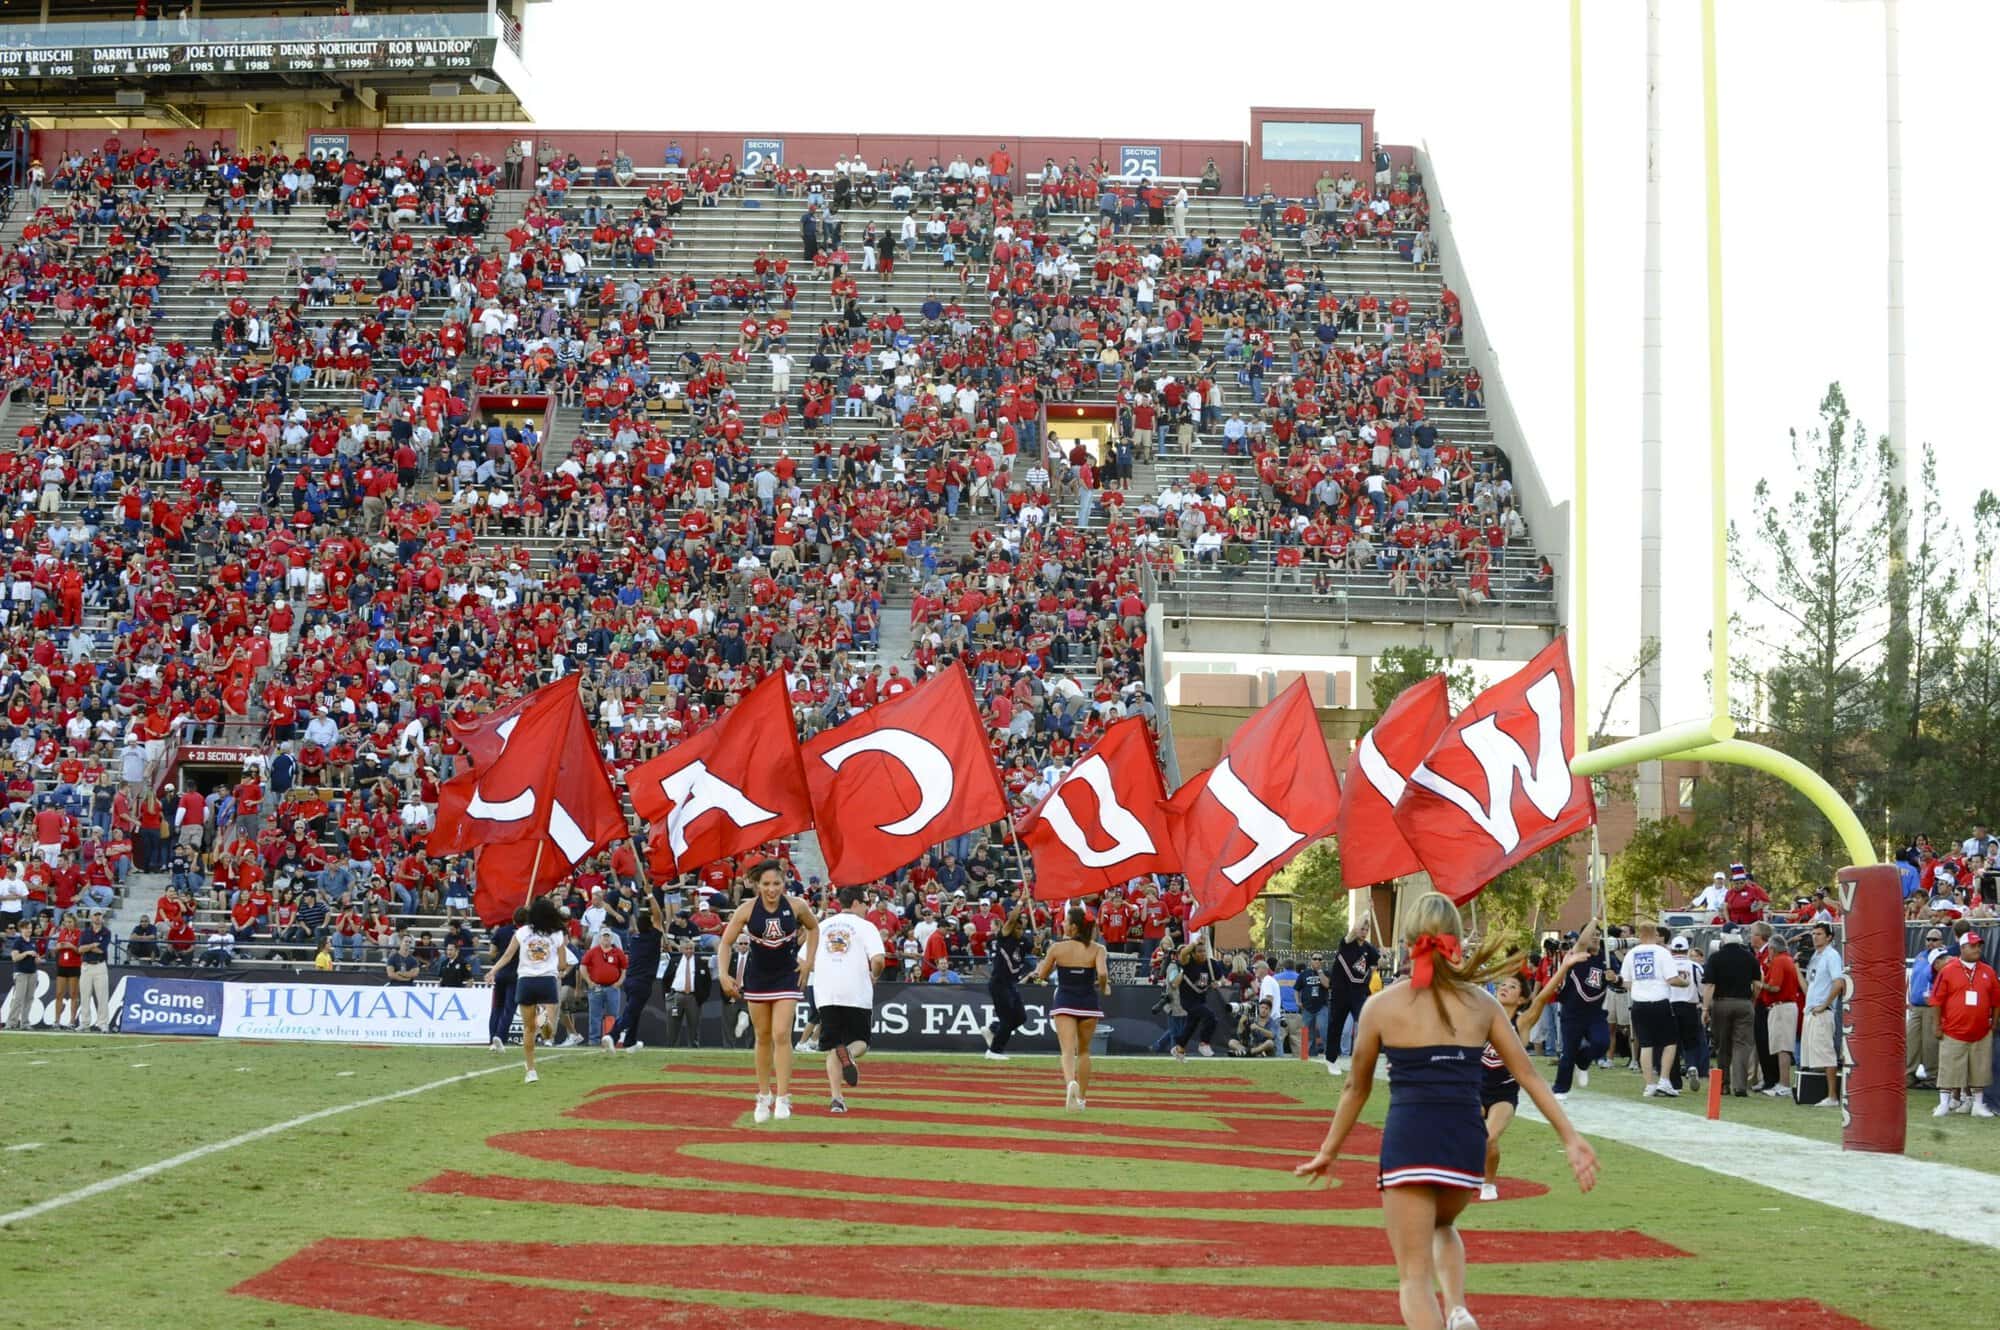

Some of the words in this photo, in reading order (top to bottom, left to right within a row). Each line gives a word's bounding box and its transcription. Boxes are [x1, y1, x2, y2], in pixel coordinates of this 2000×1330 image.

[280, 43, 316, 56] DENNIS
[319, 41, 378, 55] NORTHCUTT
[389, 41, 413, 53] ROB
[415, 40, 472, 53] WALDROP
[26, 49, 73, 62] BRUSCHI
[94, 48, 133, 60] DARRYL
[137, 46, 169, 59] LEWIS
[186, 46, 206, 62] JOE
[208, 45, 273, 58] TOFFLEMIRE
[190, 62, 214, 71] 1985
[245, 61, 270, 70] 1988
[289, 60, 313, 69] 1996
[345, 58, 369, 68] 1999
[389, 57, 414, 67] 1990
[446, 56, 471, 66] 1993
[0, 66, 20, 76] 992
[51, 65, 74, 75] 1995
[92, 64, 116, 73] 1987
[147, 63, 171, 72] 1990
[746, 151, 777, 175] 21
[1124, 158, 1157, 178] 25
[207, 751, 237, 761] SECTION
[143, 989, 205, 1009] Game
[240, 988, 472, 1021] HUMANA
[129, 1004, 216, 1025] Sponsor
[236, 1017, 320, 1036] Guidance
[325, 1024, 360, 1037] when
[365, 1029, 388, 1039] you
[391, 1026, 422, 1039] need
[441, 1030, 472, 1039] most
